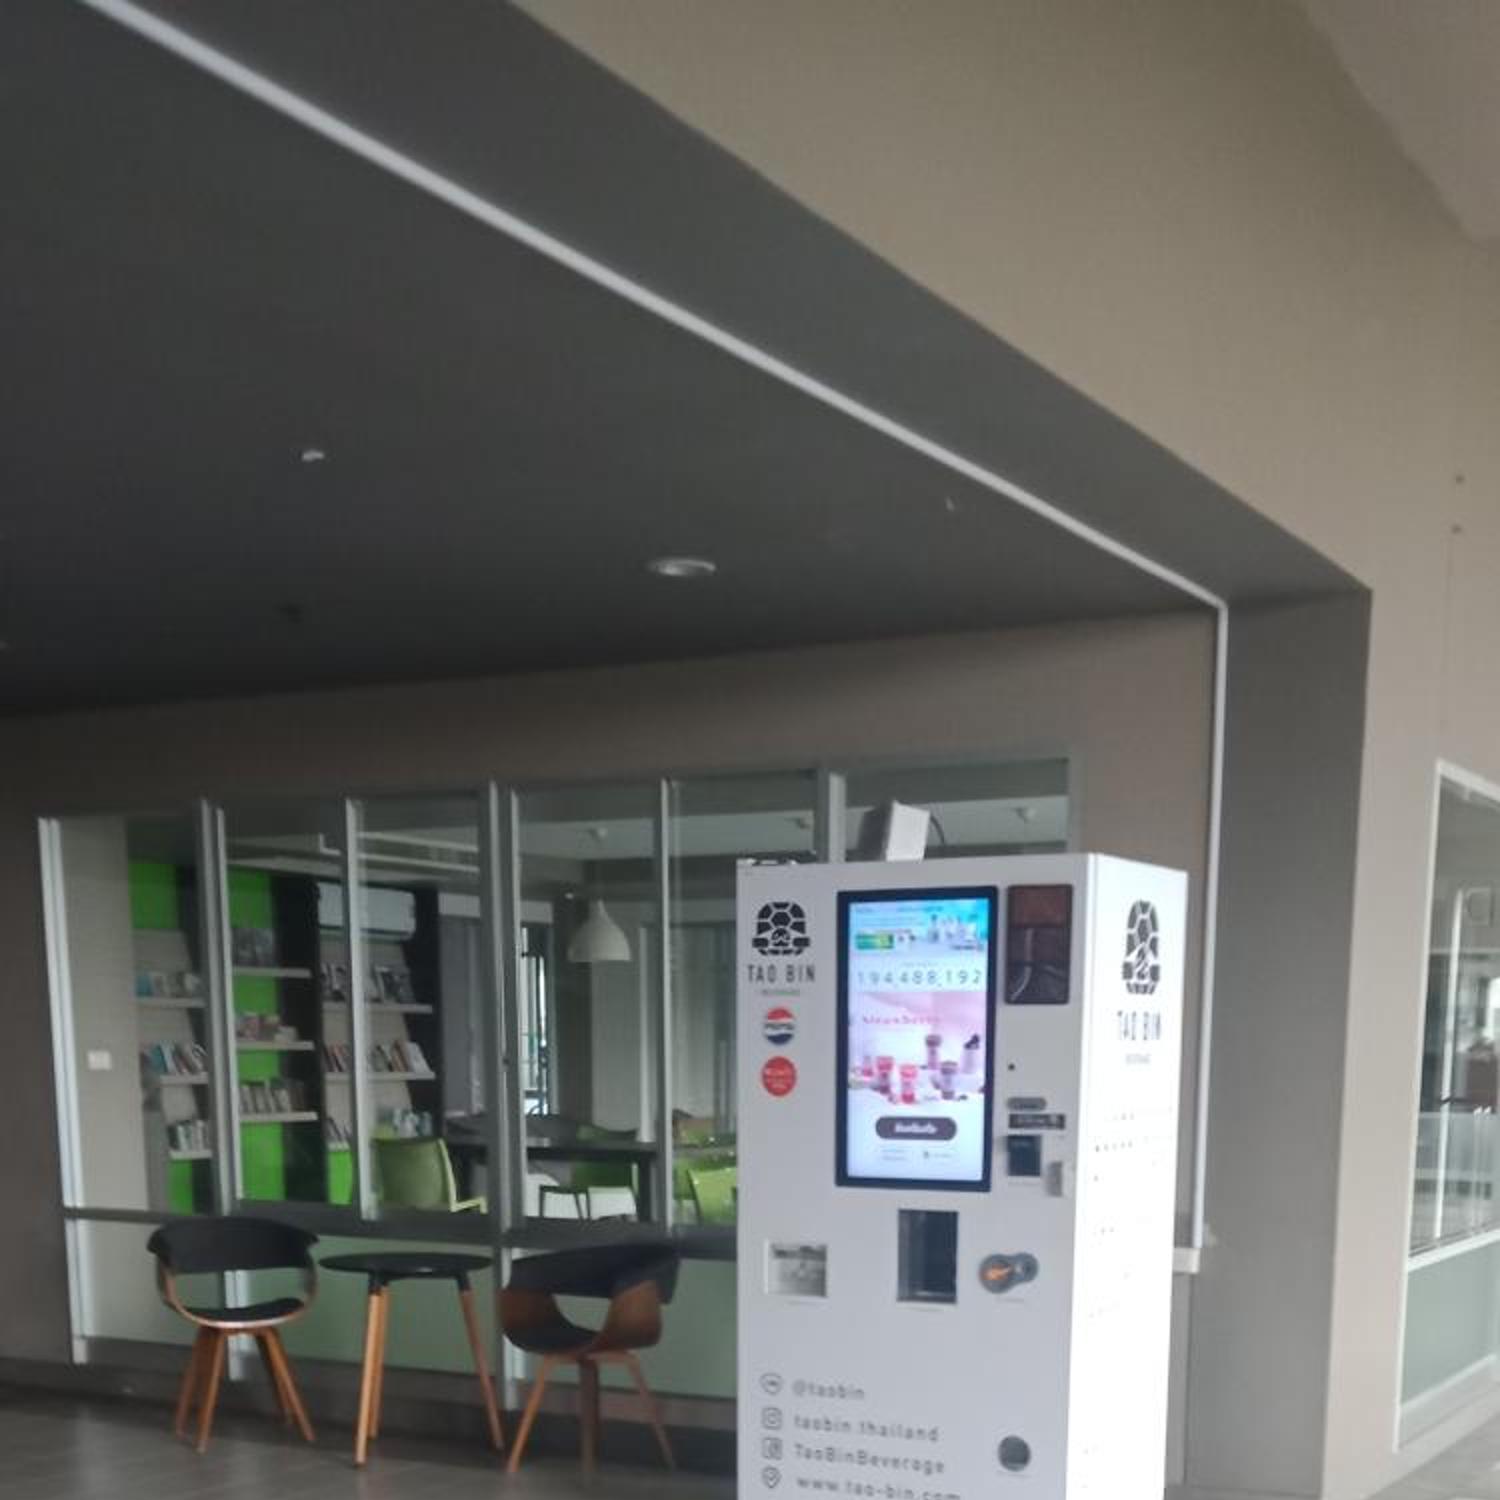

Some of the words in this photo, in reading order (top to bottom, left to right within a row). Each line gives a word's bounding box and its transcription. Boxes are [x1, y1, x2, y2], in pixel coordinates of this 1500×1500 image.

[747, 964, 778, 984] TAO
[786, 964, 816, 983] BIN
[792, 1378, 865, 1399] @taobin
